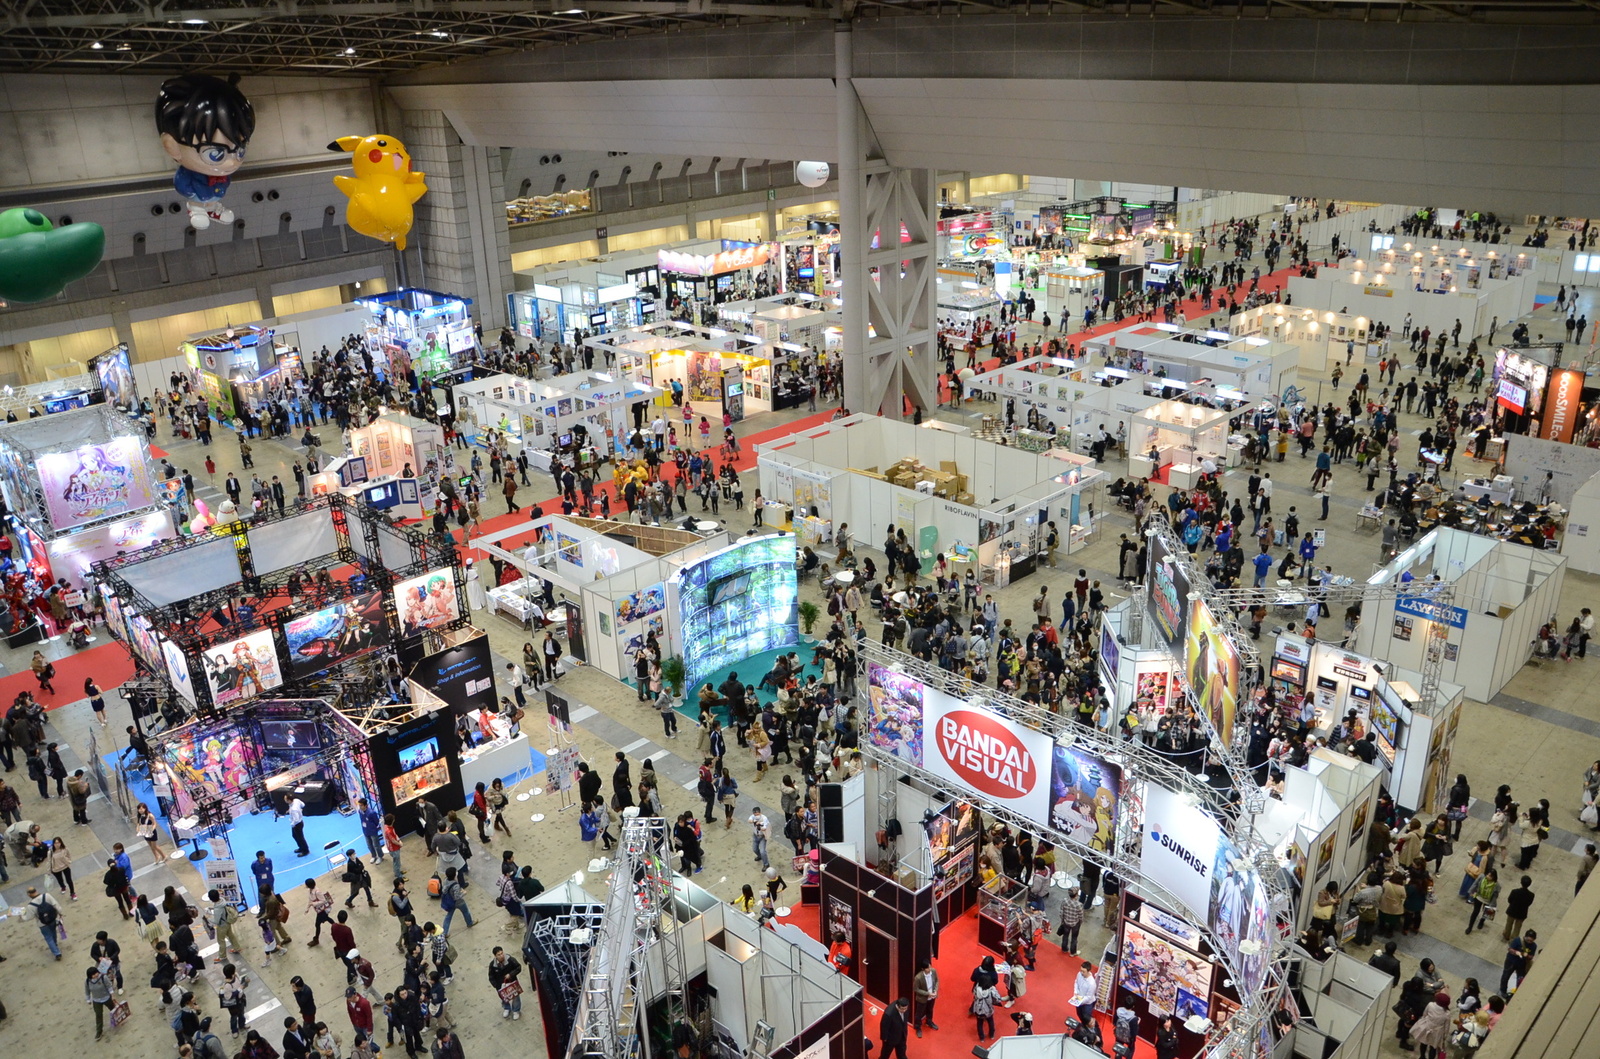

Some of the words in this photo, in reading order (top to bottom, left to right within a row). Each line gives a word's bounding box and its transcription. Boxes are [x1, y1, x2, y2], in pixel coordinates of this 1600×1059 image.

[944, 504, 978, 520] RIBOFLAVIN
[436, 675, 450, 686] Shop
[942, 716, 1030, 773] BANDAI
[942, 737, 1028, 794] VISUAL
[1161, 833, 1208, 878] SUNRISE
